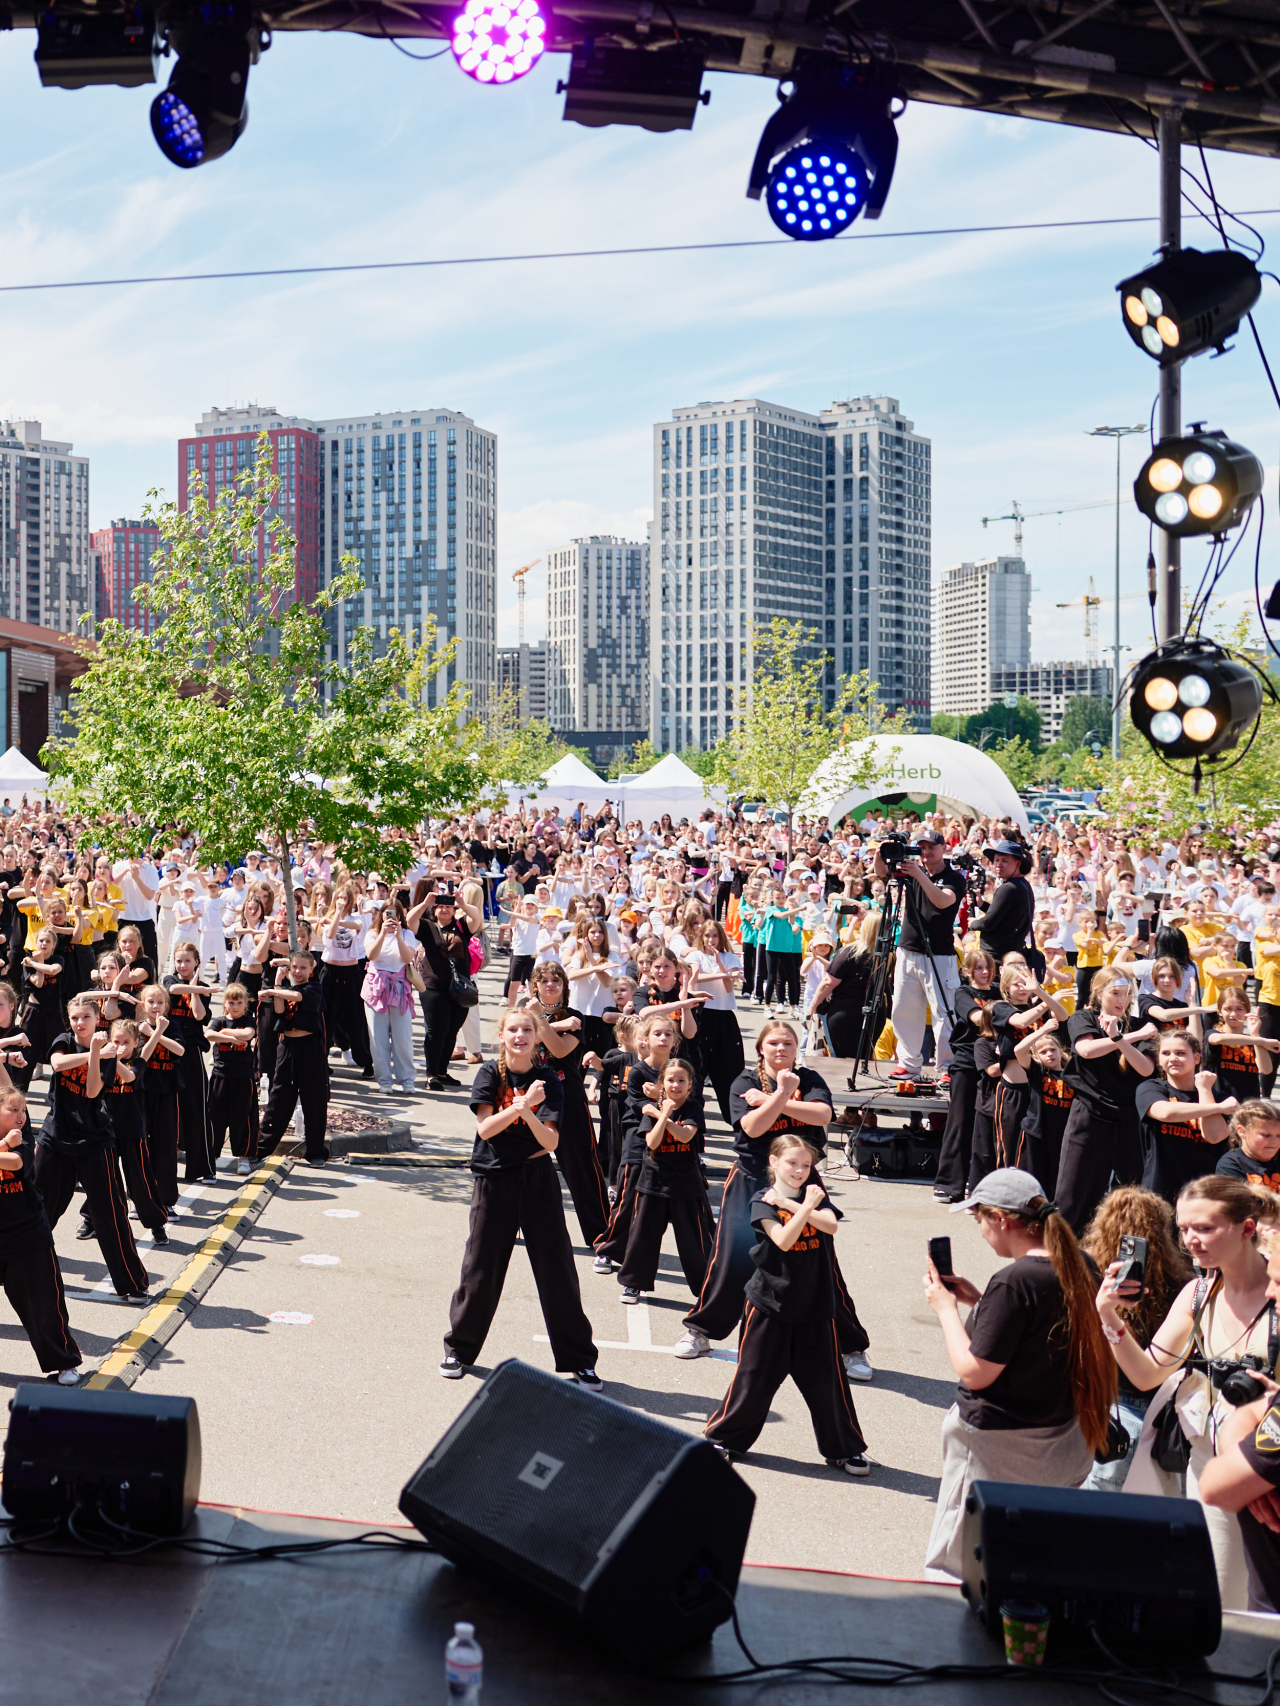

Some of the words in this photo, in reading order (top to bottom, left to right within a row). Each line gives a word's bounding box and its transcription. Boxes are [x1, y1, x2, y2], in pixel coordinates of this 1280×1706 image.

[1220, 1061, 1246, 1072] STUDIO
[1248, 1066, 1259, 1074] FA
[1161, 1123, 1194, 1139] STUDI
